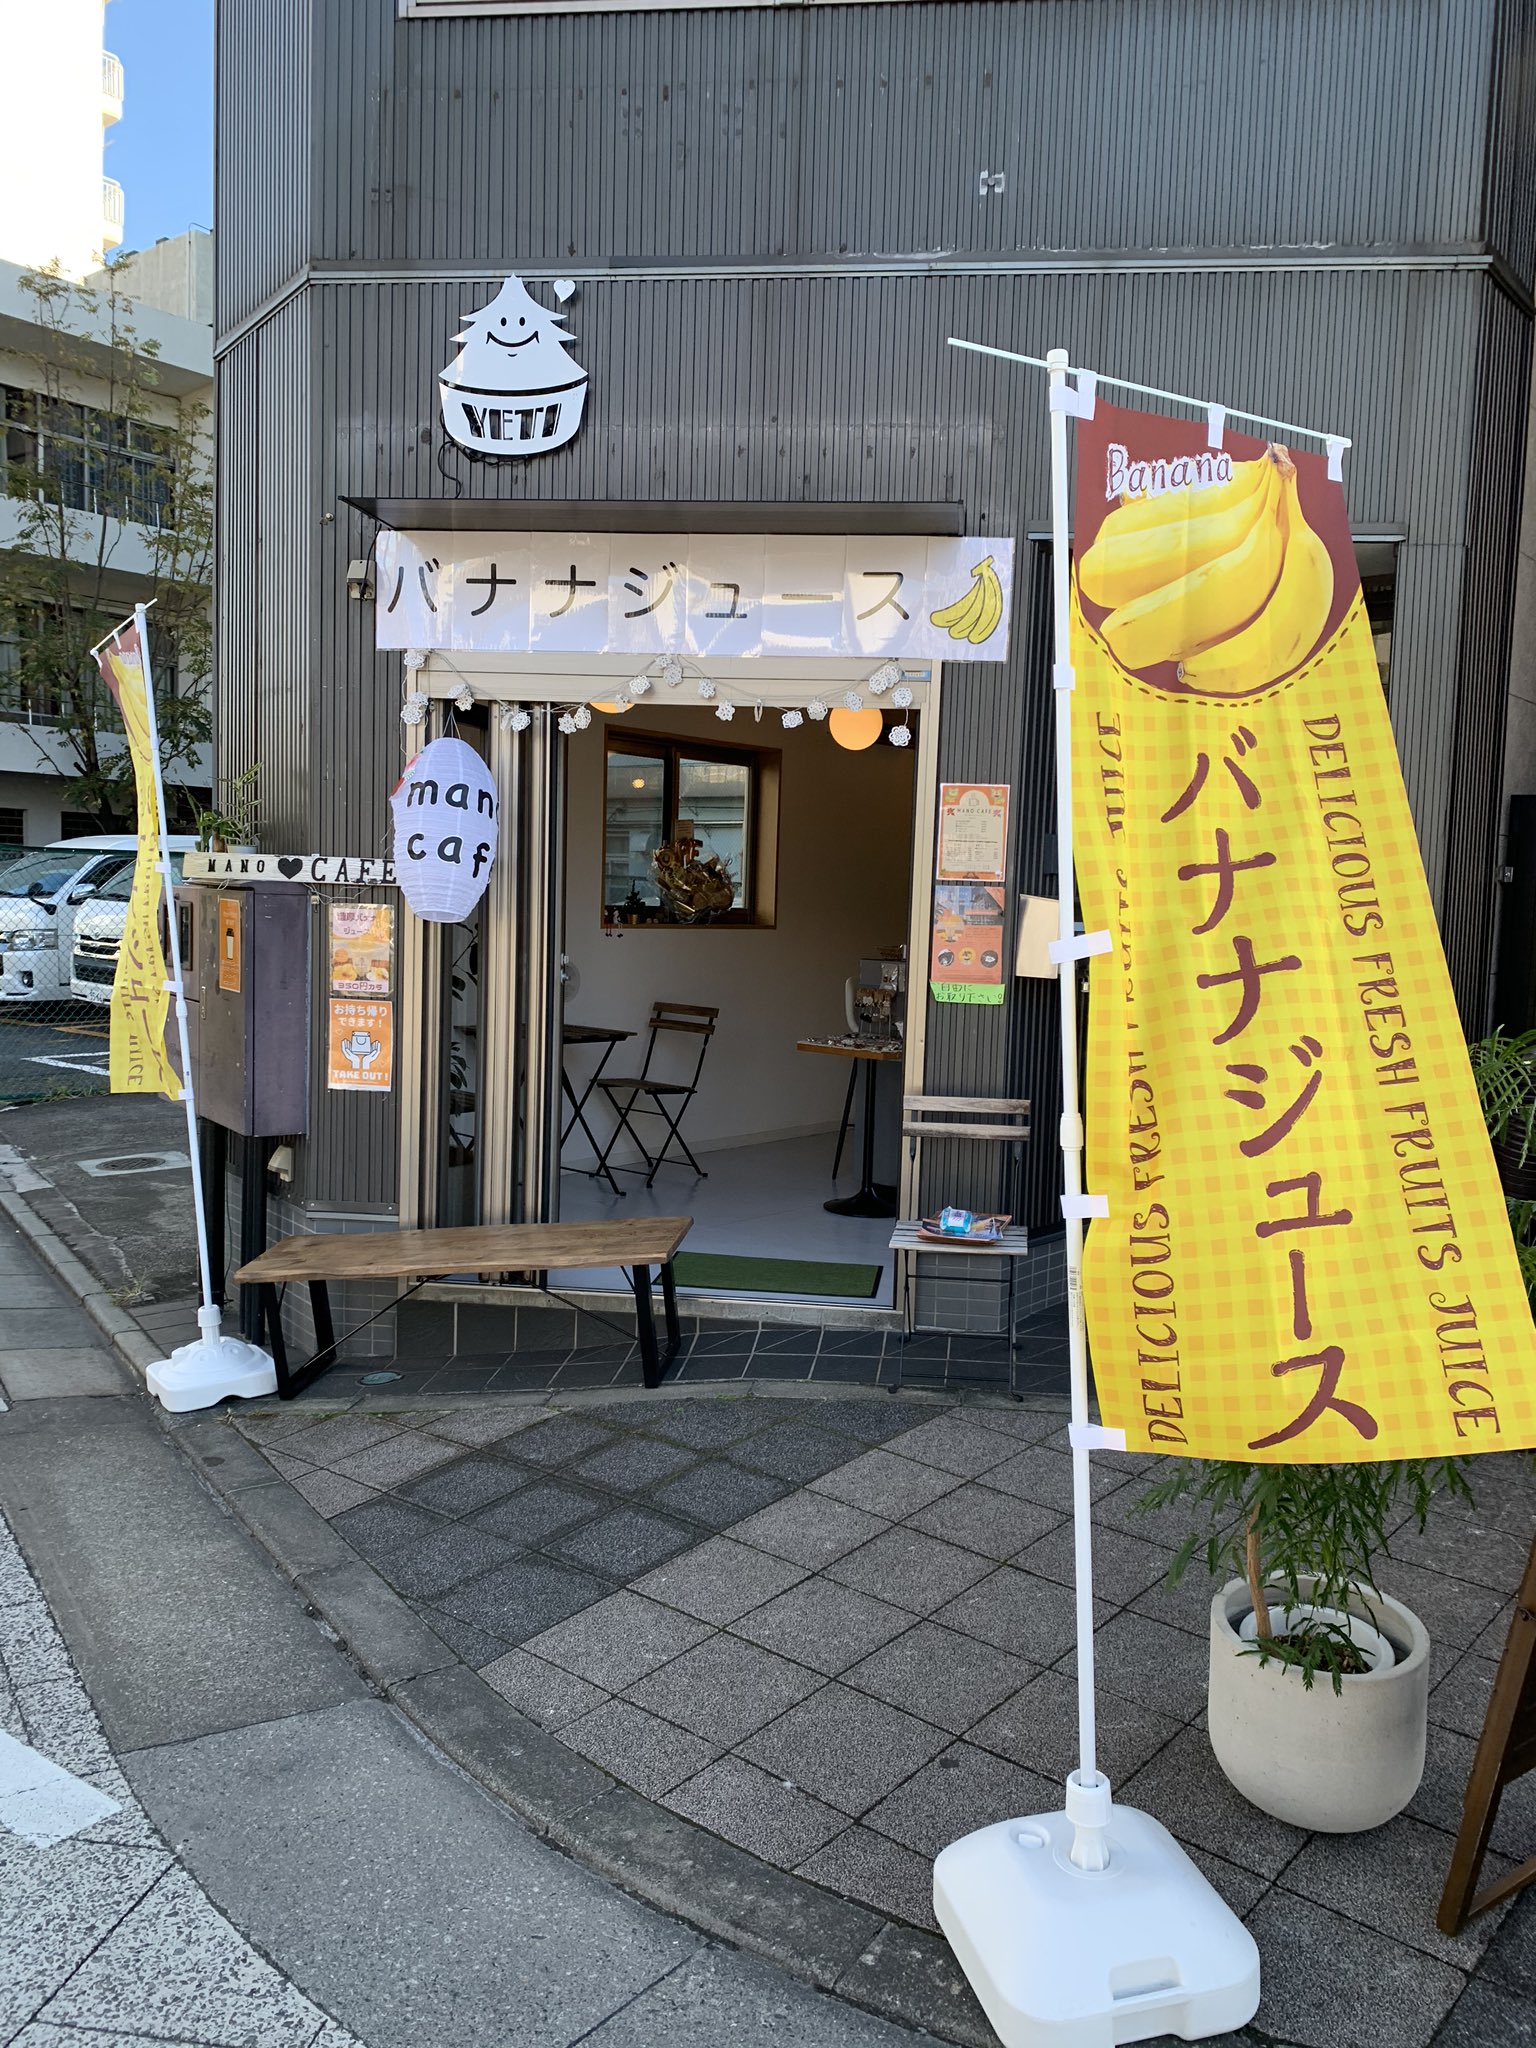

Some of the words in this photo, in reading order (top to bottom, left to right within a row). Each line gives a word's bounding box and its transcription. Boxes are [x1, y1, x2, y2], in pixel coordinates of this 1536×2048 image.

[461, 403, 562, 440] YETI
[1107, 445, 1233, 498] Banana
[387, 557, 910, 621] バナナジュース
[407, 780, 499, 824] man
[1303, 714, 1384, 937] DELICIOUS
[208, 858, 265, 873] MANO
[311, 857, 397, 885] CAFE
[407, 833, 494, 882] caf
[334, 1004, 388, 1017] お持ち帰り
[338, 982, 383, 991] 350円カラ
[1352, 952, 1420, 1087] FRESH
[332, 1070, 360, 1079] TAKE
[1161, 725, 1379, 1450] バナナジュース
[1385, 1102, 1462, 1271] FRUITS
[1131, 1203, 1189, 1445] DELICIOUS
[1430, 1291, 1501, 1439] JUICE
